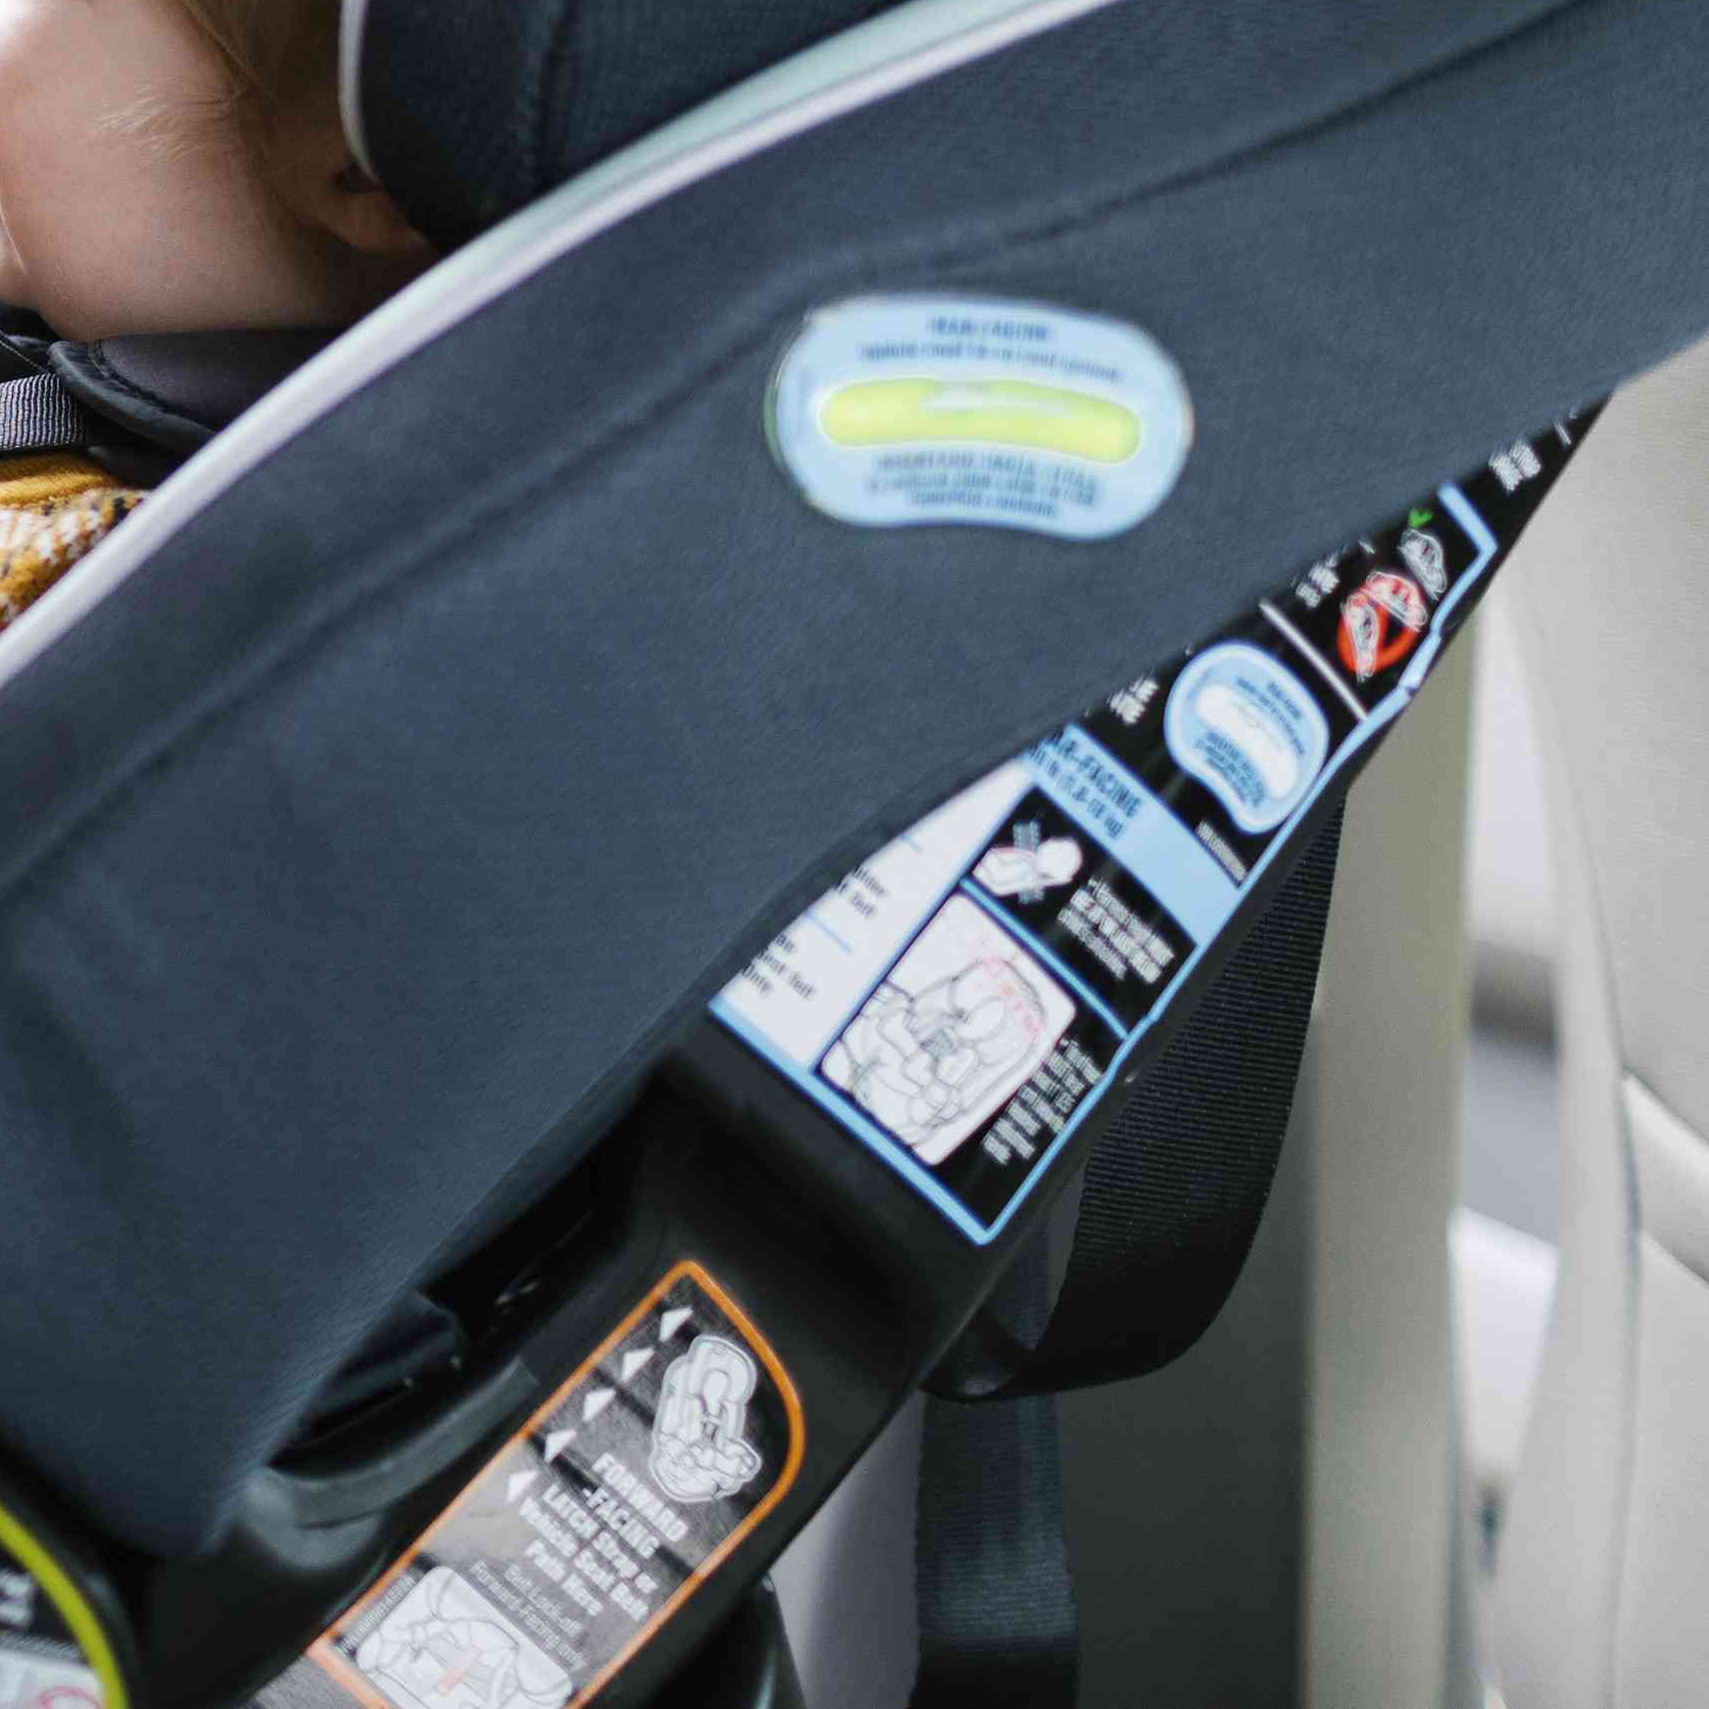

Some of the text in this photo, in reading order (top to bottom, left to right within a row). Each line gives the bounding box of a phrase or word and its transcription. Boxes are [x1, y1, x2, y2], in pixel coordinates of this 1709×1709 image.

[541, 1484, 660, 1598] LATCH Strap or
[592, 1451, 691, 1545] FORWARD
[516, 1496, 650, 1624] Vehicle Seat Belt
[524, 1539, 605, 1619] Path Here
